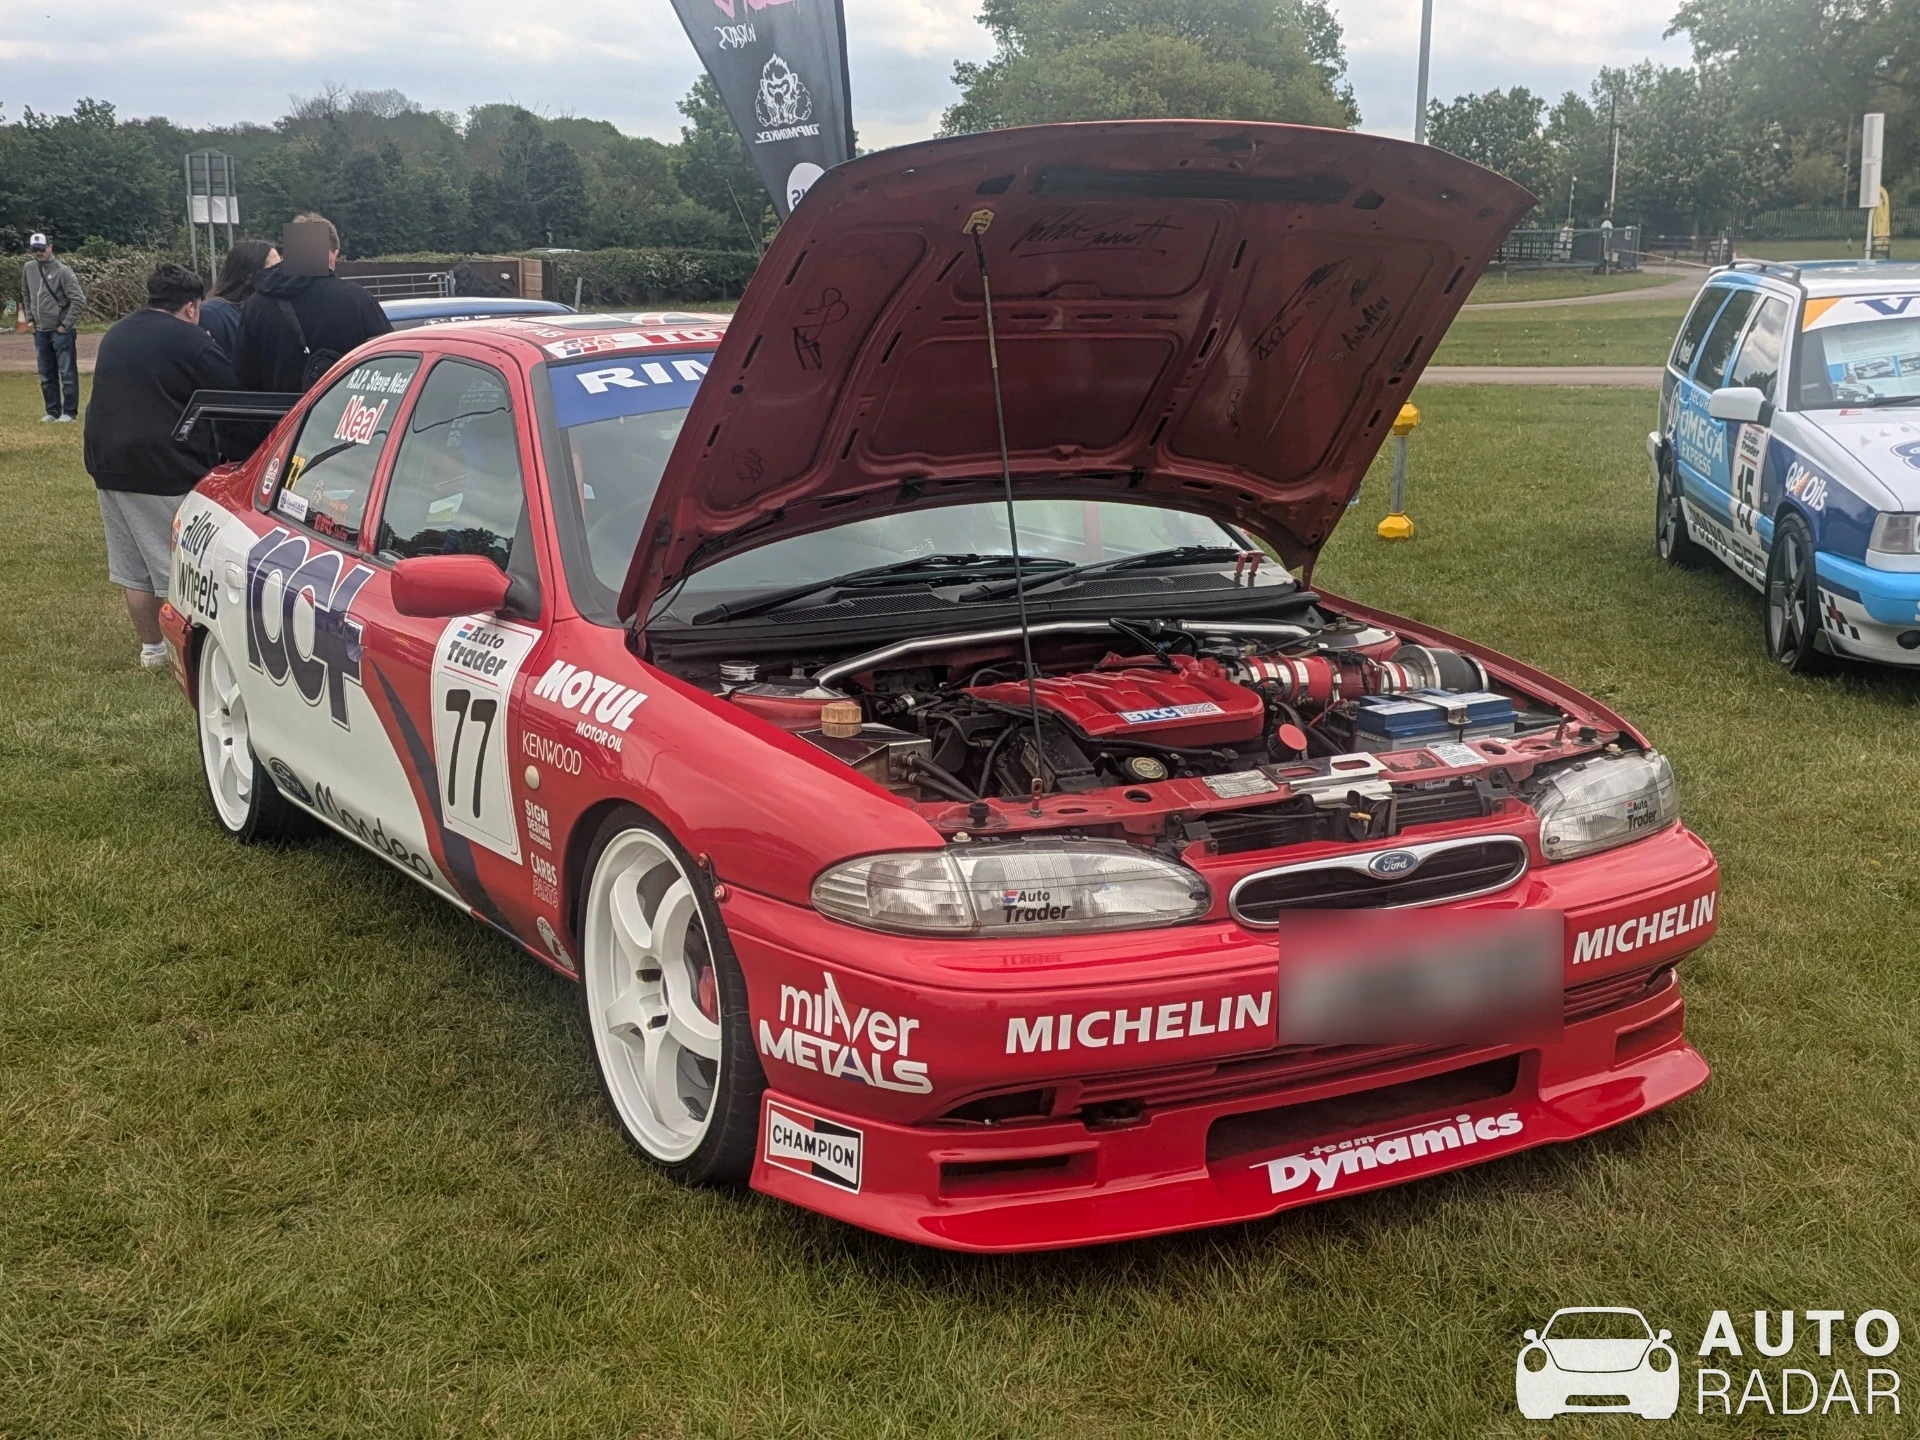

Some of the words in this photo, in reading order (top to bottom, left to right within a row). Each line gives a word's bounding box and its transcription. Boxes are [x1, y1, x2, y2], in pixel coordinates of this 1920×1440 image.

[556, 335, 622, 351] TOTAL
[366, 370, 391, 393] Steve
[387, 372, 413, 394] Neal
[1690, 388, 1711, 409] SECUR
[333, 395, 388, 445] Neal
[1681, 409, 1724, 463] OMEGA
[1681, 442, 1711, 475] EXPRESS
[1741, 440, 1760, 458] Trader
[1801, 475, 1828, 512] Oils
[181, 511, 219, 568] alloy
[1688, 504, 1728, 557] VOLVO
[178, 559, 218, 620] wheels
[466, 626, 505, 649] Auto
[447, 640, 507, 677] Trader
[533, 660, 648, 731] MOTUL
[1121, 707, 1175, 722] BTCC
[446, 689, 497, 818] 77
[522, 730, 582, 775] KENWOOD
[575, 721, 608, 744] MOTOR
[608, 735, 622, 752] OIL
[525, 799, 549, 827] SIGN
[1627, 809, 1657, 830] Trader
[1633, 800, 1648, 812] Auto
[315, 782, 433, 881] Mondeo
[527, 817, 551, 841] DESIGN
[531, 852, 557, 887] CARBS
[1383, 856, 1408, 871] Ford
[533, 875, 558, 908] PARTS
[1017, 890, 1050, 903] Auto
[1003, 903, 1070, 923] Trader
[1572, 891, 1716, 965] MICHELIN
[1005, 990, 1272, 1054] MICHELIN
[759, 1019, 933, 1095] METALS
[772, 1124, 854, 1169] CHAMPION
[1268, 1112, 1523, 1194] Dynamics
[1311, 1135, 1374, 1155] team
